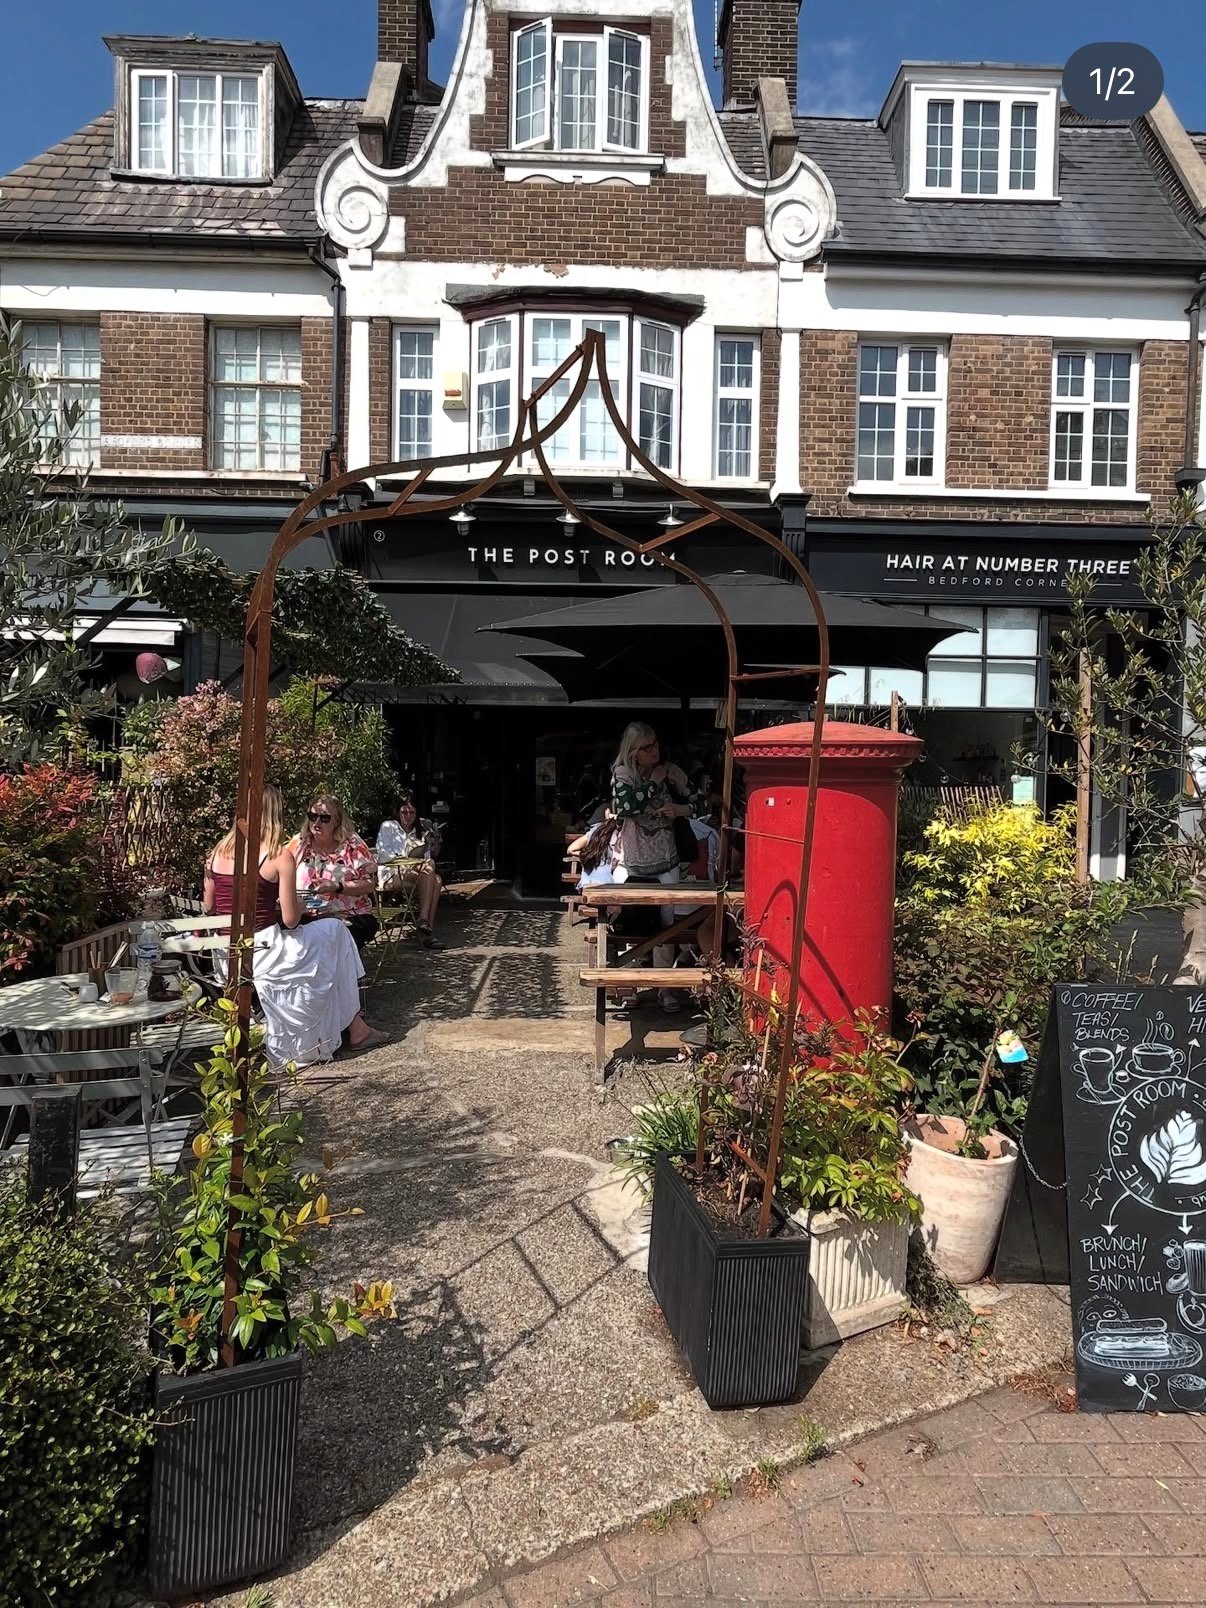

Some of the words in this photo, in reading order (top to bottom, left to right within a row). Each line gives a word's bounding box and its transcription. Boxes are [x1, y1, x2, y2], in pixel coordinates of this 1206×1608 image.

[468, 547, 514, 564] THE
[529, 549, 590, 565] POST
[886, 554, 934, 570] HAIR
[941, 555, 969, 571] AT
[975, 556, 1059, 573] NUMBER
[1067, 559, 1131, 575] THREE
[928, 576, 1003, 586] BEDFORD
[1075, 1028, 1130, 1041] BLENDS
[1133, 1080, 1187, 1109] ROOM
[1112, 1105, 1137, 1157] POST
[1119, 1164, 1155, 1204] THE
[1087, 1272, 1164, 1295] SANDWICH
